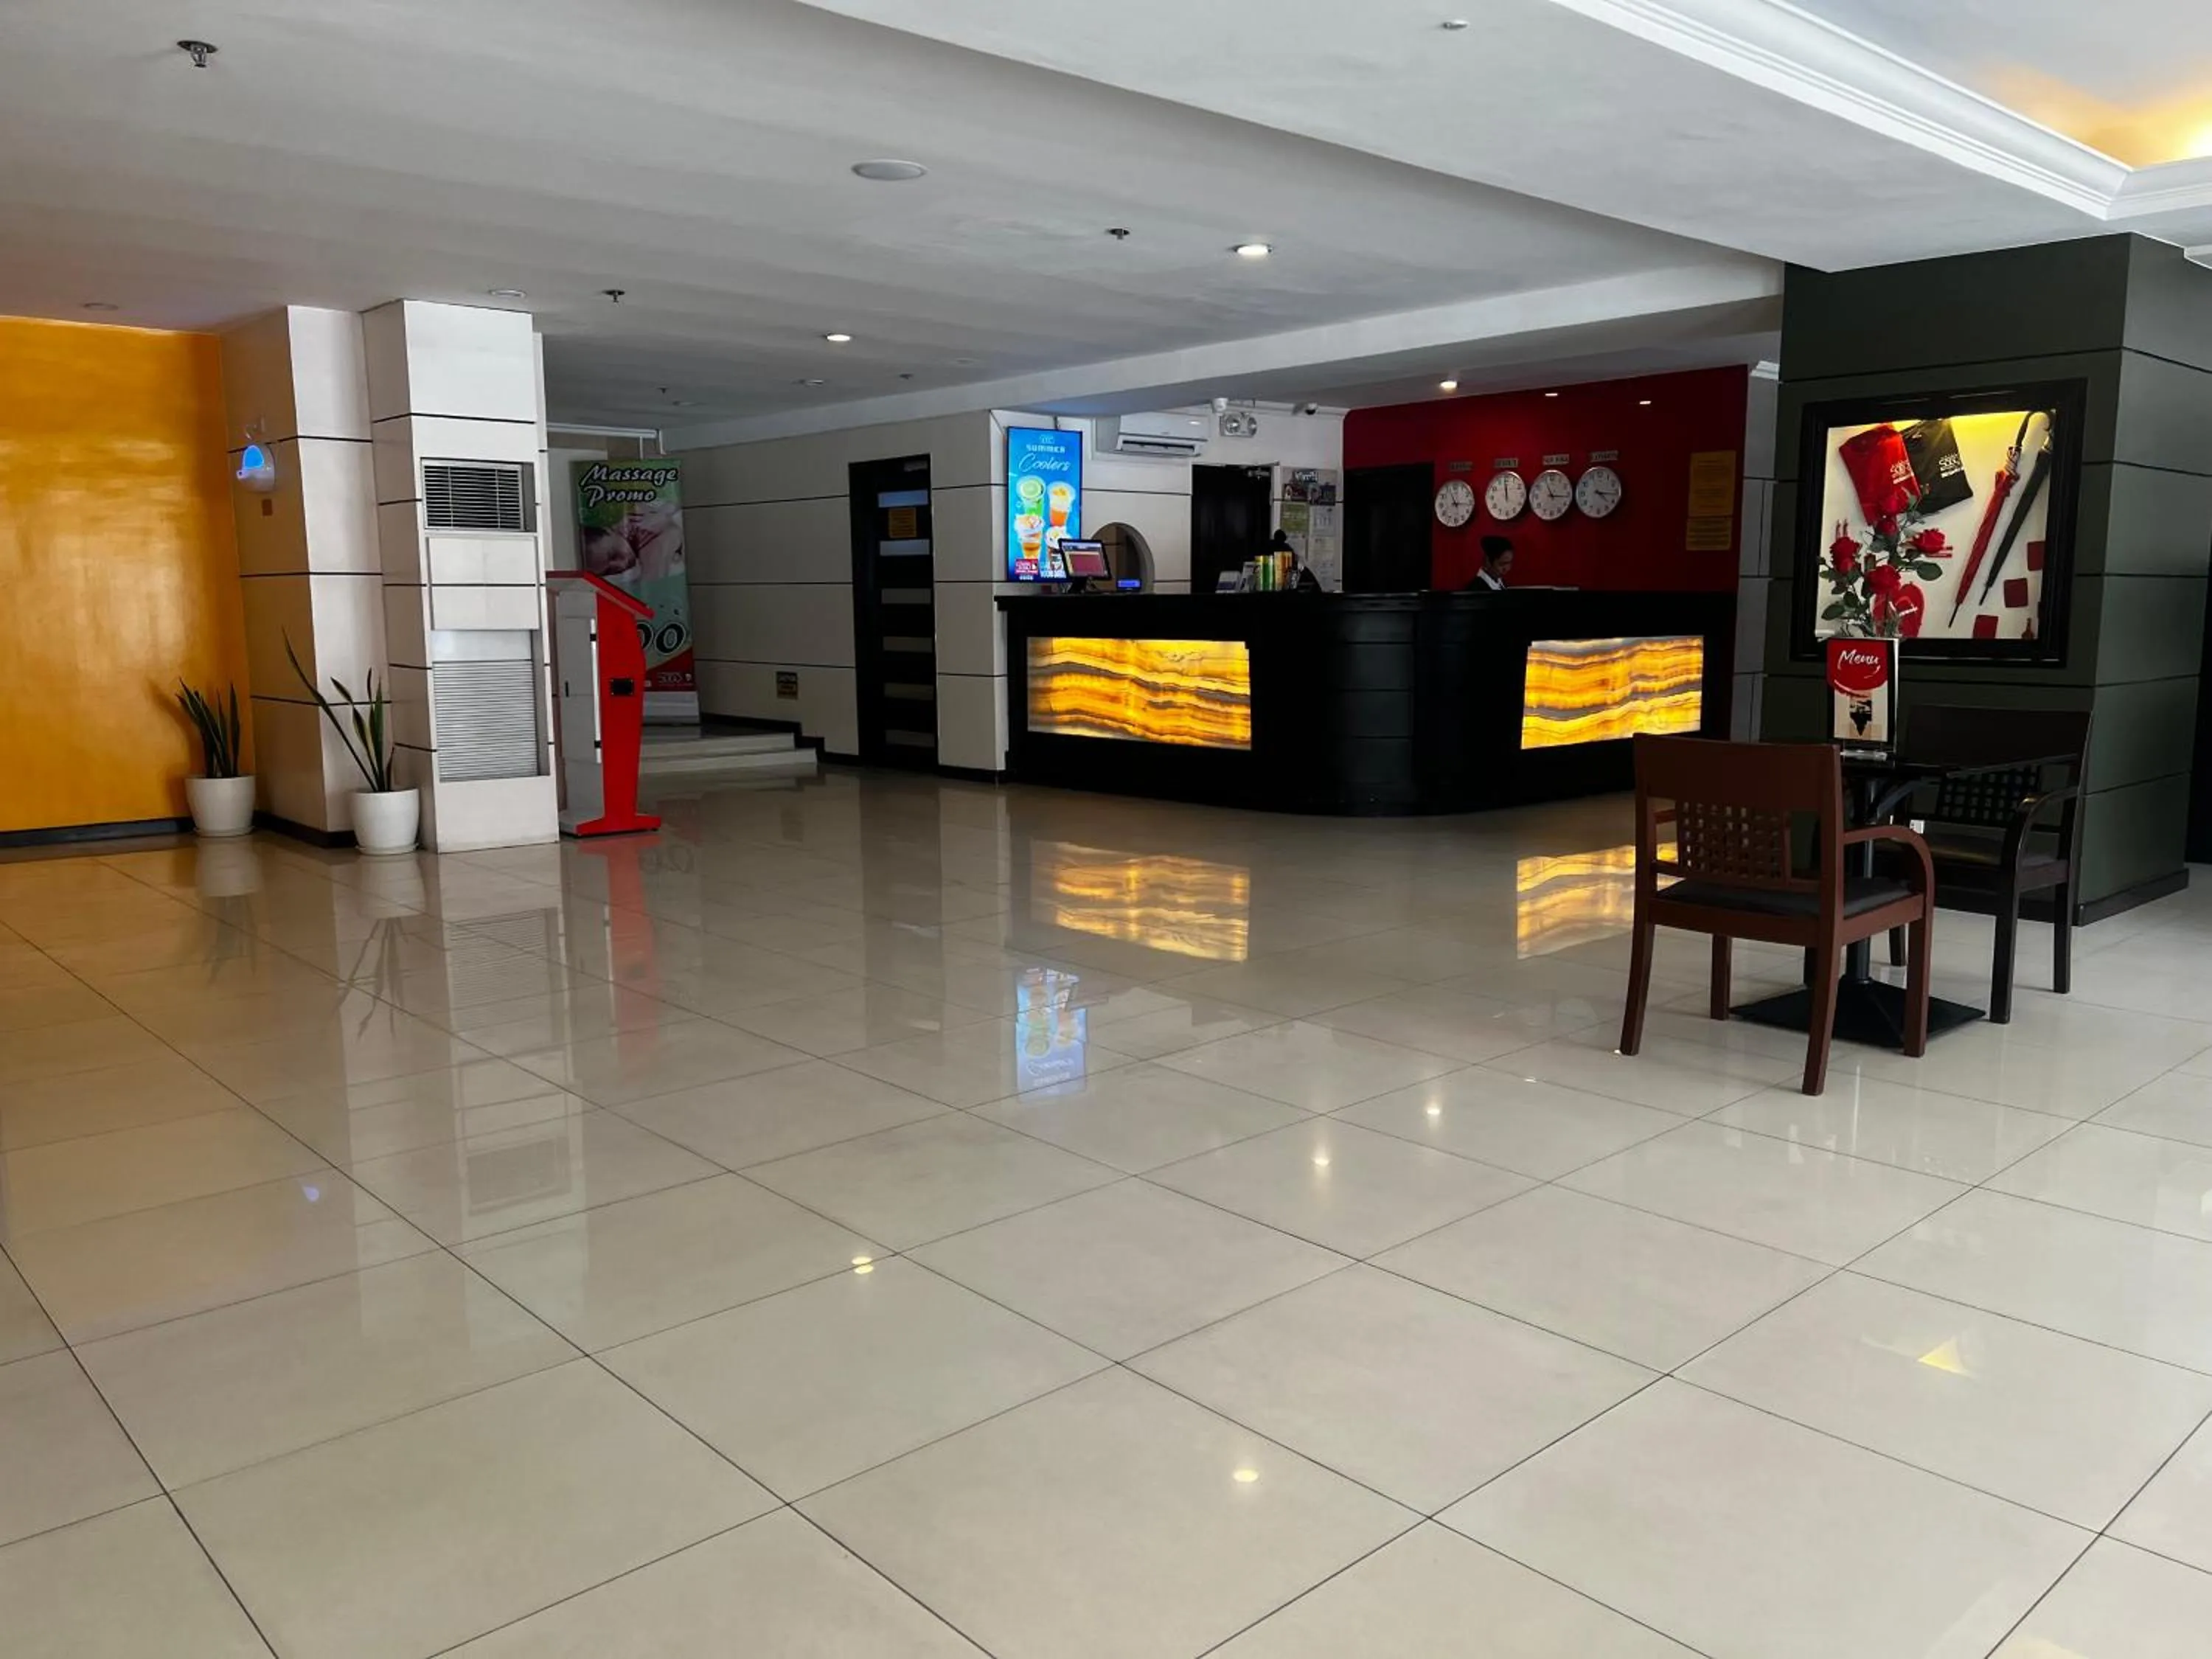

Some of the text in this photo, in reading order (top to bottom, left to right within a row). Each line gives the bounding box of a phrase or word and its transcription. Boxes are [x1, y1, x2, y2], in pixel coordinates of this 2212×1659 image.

[1019, 452, 1071, 472] Coolers
[580, 464, 678, 486] Massage
[582, 484, 656, 507] Promo
[1837, 649, 1880, 669] Menu
